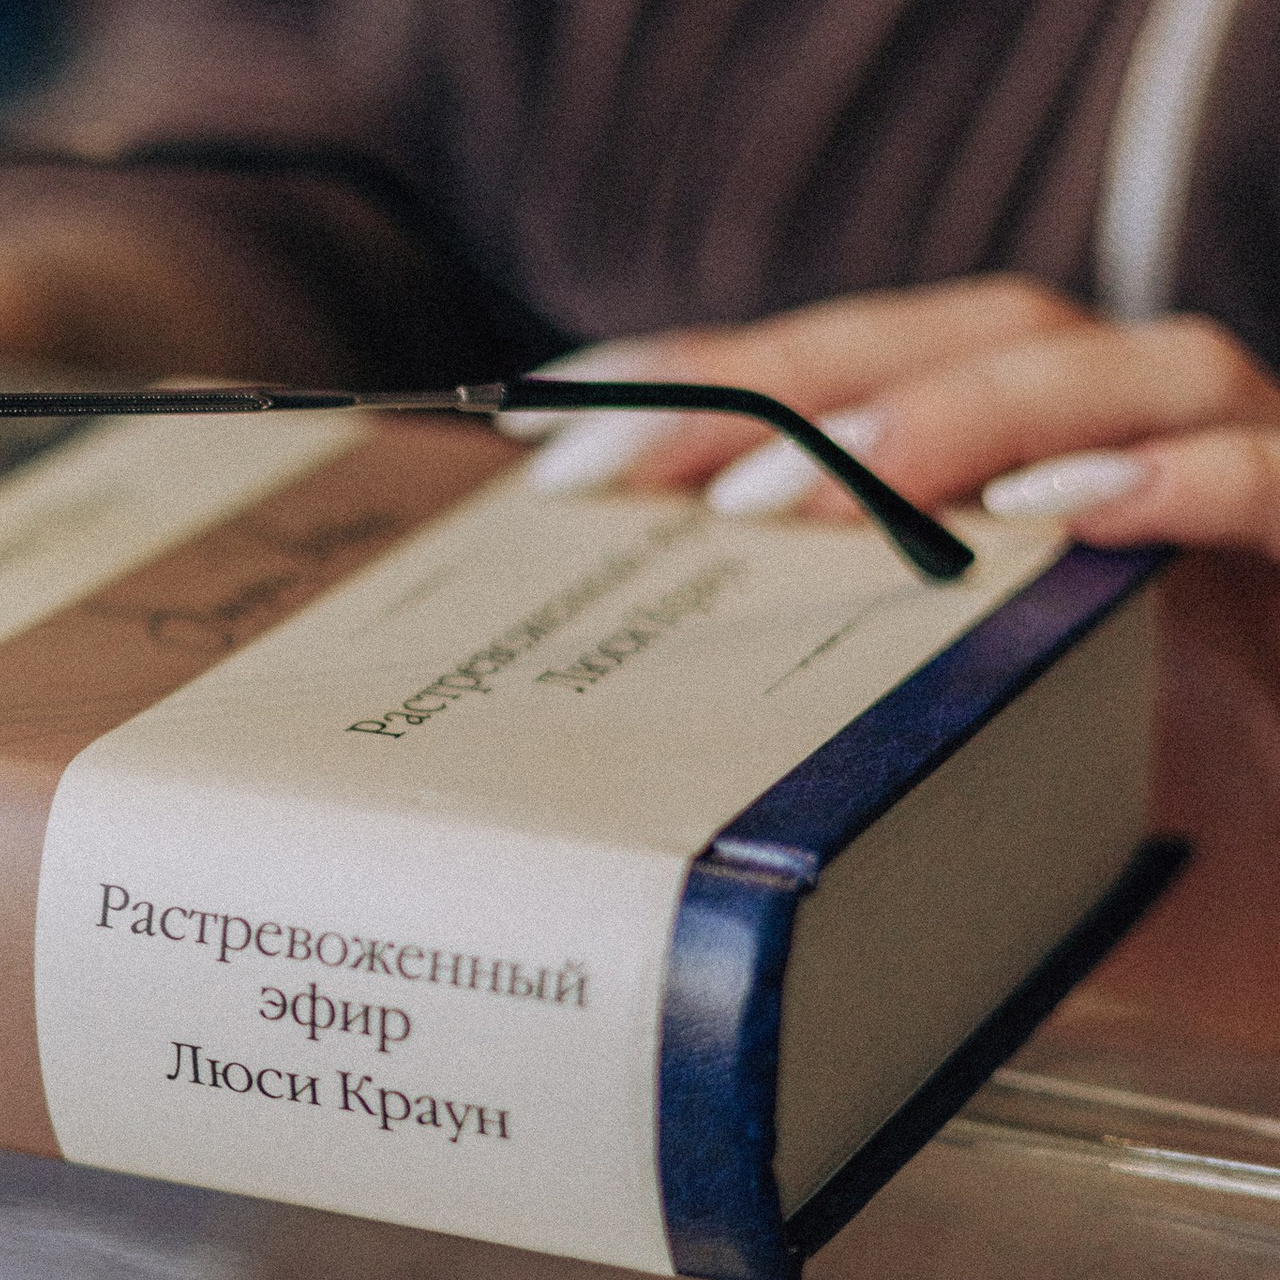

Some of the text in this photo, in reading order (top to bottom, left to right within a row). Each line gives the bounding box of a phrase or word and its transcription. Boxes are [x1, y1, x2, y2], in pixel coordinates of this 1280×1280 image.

[95, 882, 590, 1008] Растревоженный
[259, 983, 412, 1052] эфир
[167, 1042, 511, 1144] Люси Краун
